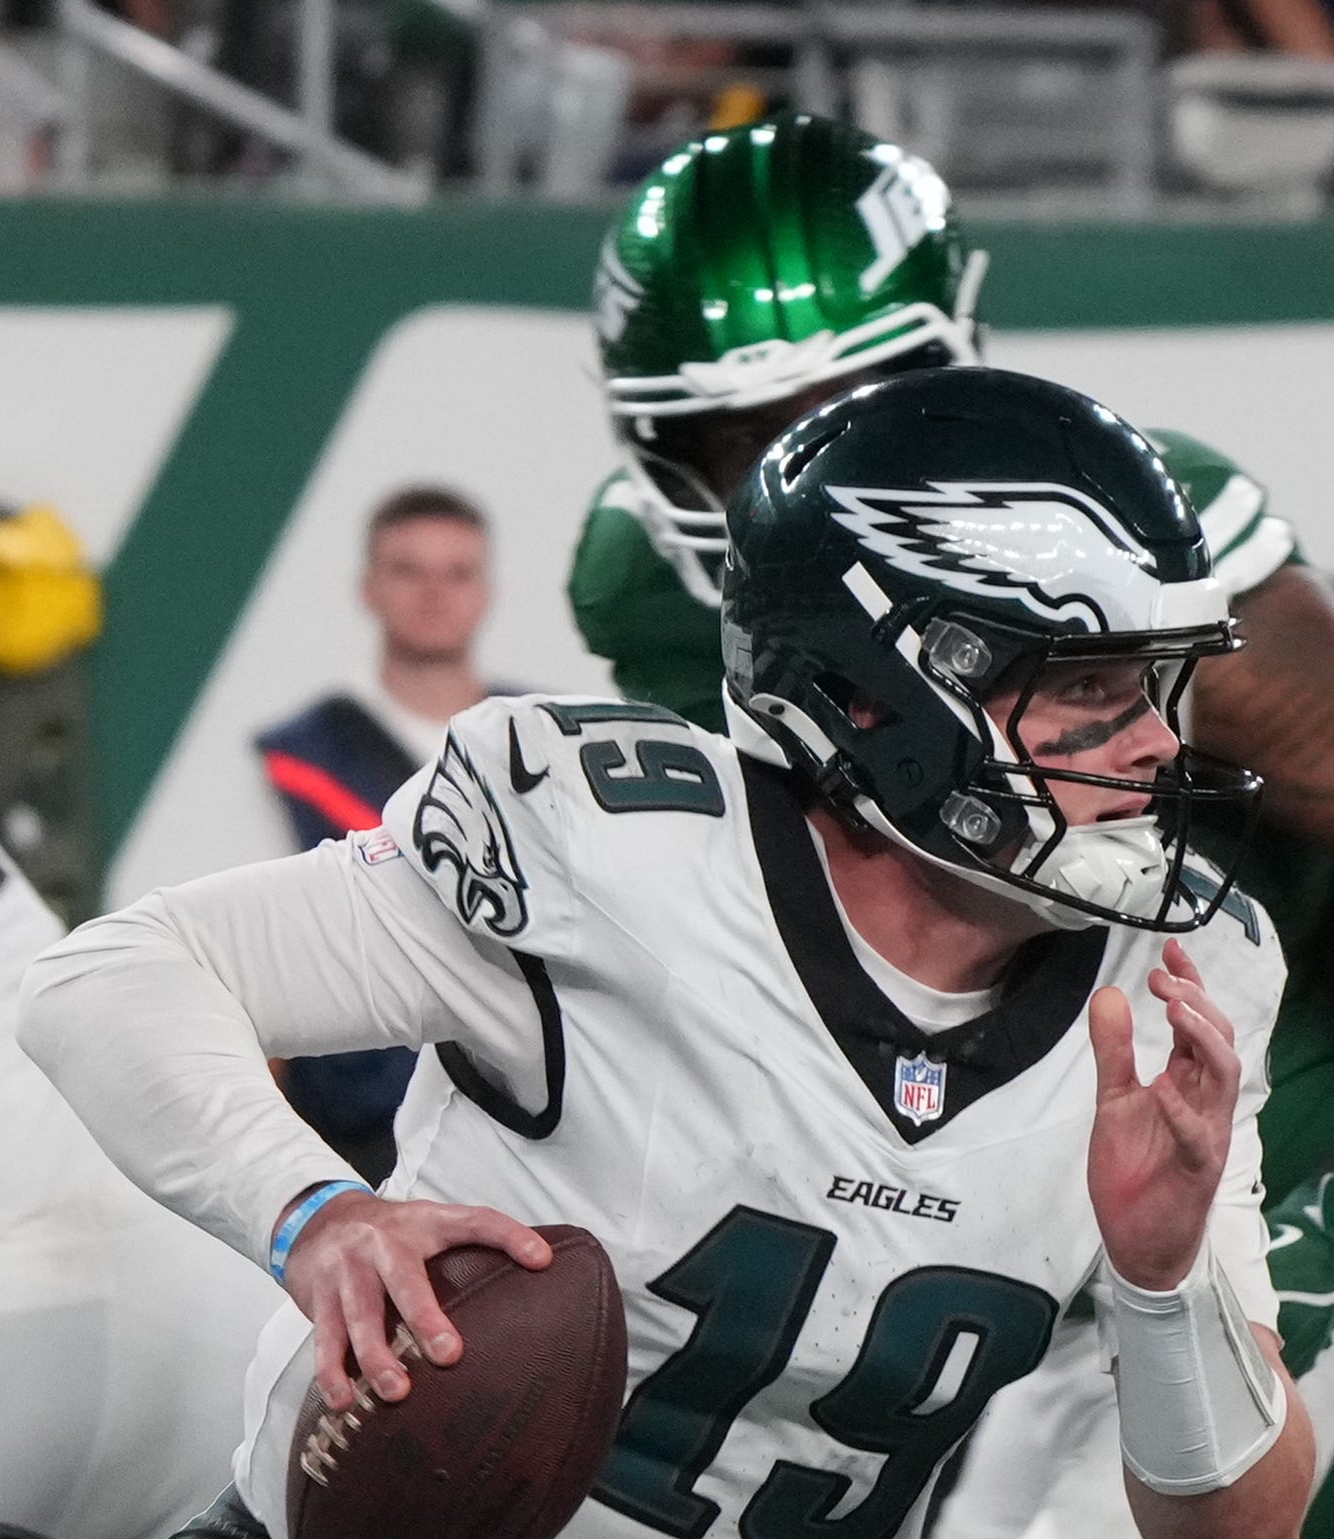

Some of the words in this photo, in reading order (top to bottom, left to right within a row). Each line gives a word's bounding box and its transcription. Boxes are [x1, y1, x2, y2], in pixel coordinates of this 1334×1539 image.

[534, 701, 726, 818] 19
[903, 1083, 936, 1111] NFL
[825, 1175, 963, 1223] EAGLES
